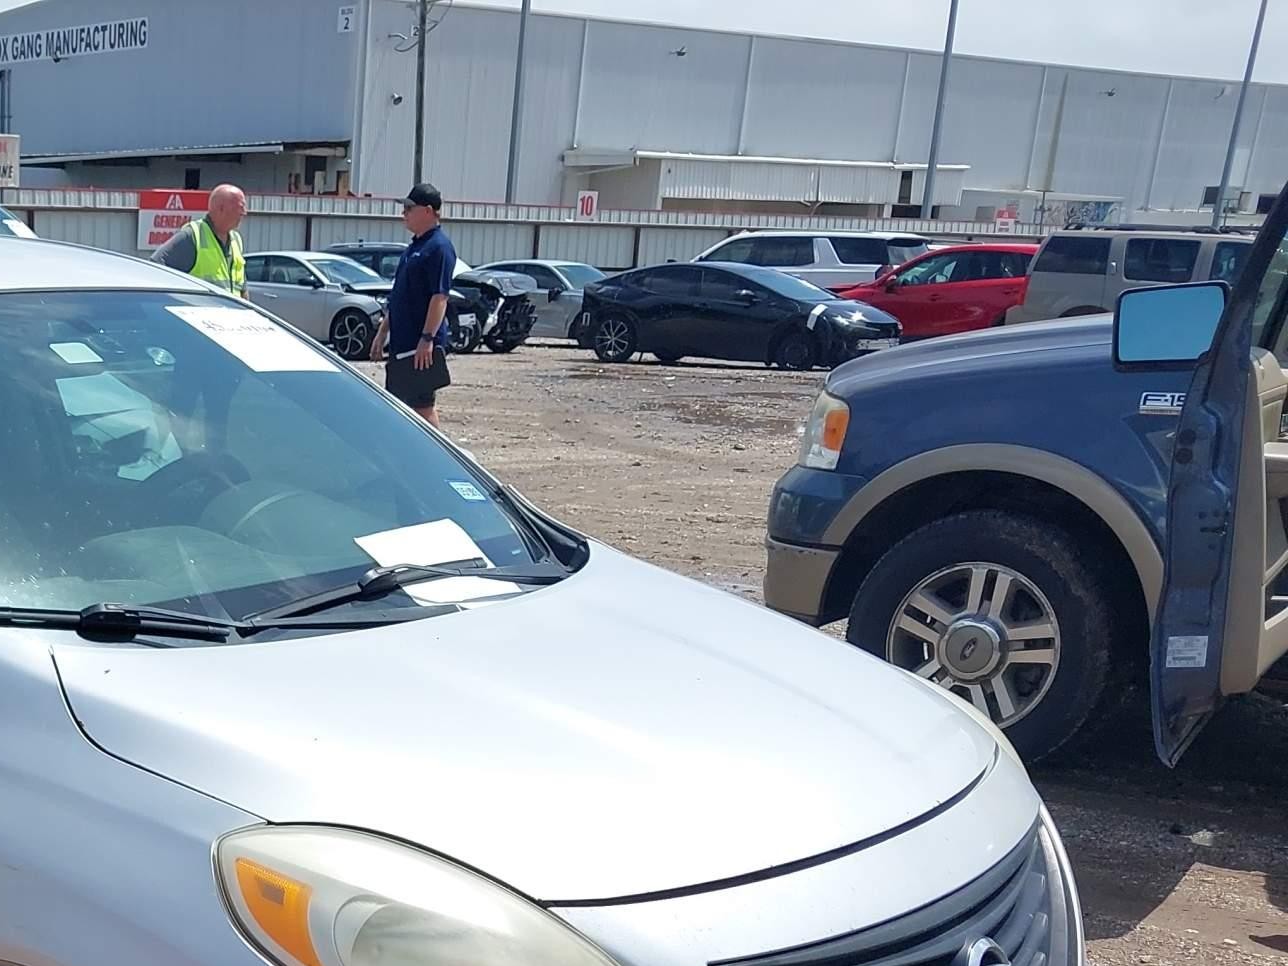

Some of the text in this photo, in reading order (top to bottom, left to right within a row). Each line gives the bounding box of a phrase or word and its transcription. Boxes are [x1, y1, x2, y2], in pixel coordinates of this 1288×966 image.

[344, 17, 350, 30] 2
[12, 33, 42, 61] GANG
[46, 19, 147, 58] MANUFACTURING
[580, 195, 593, 216] 10
